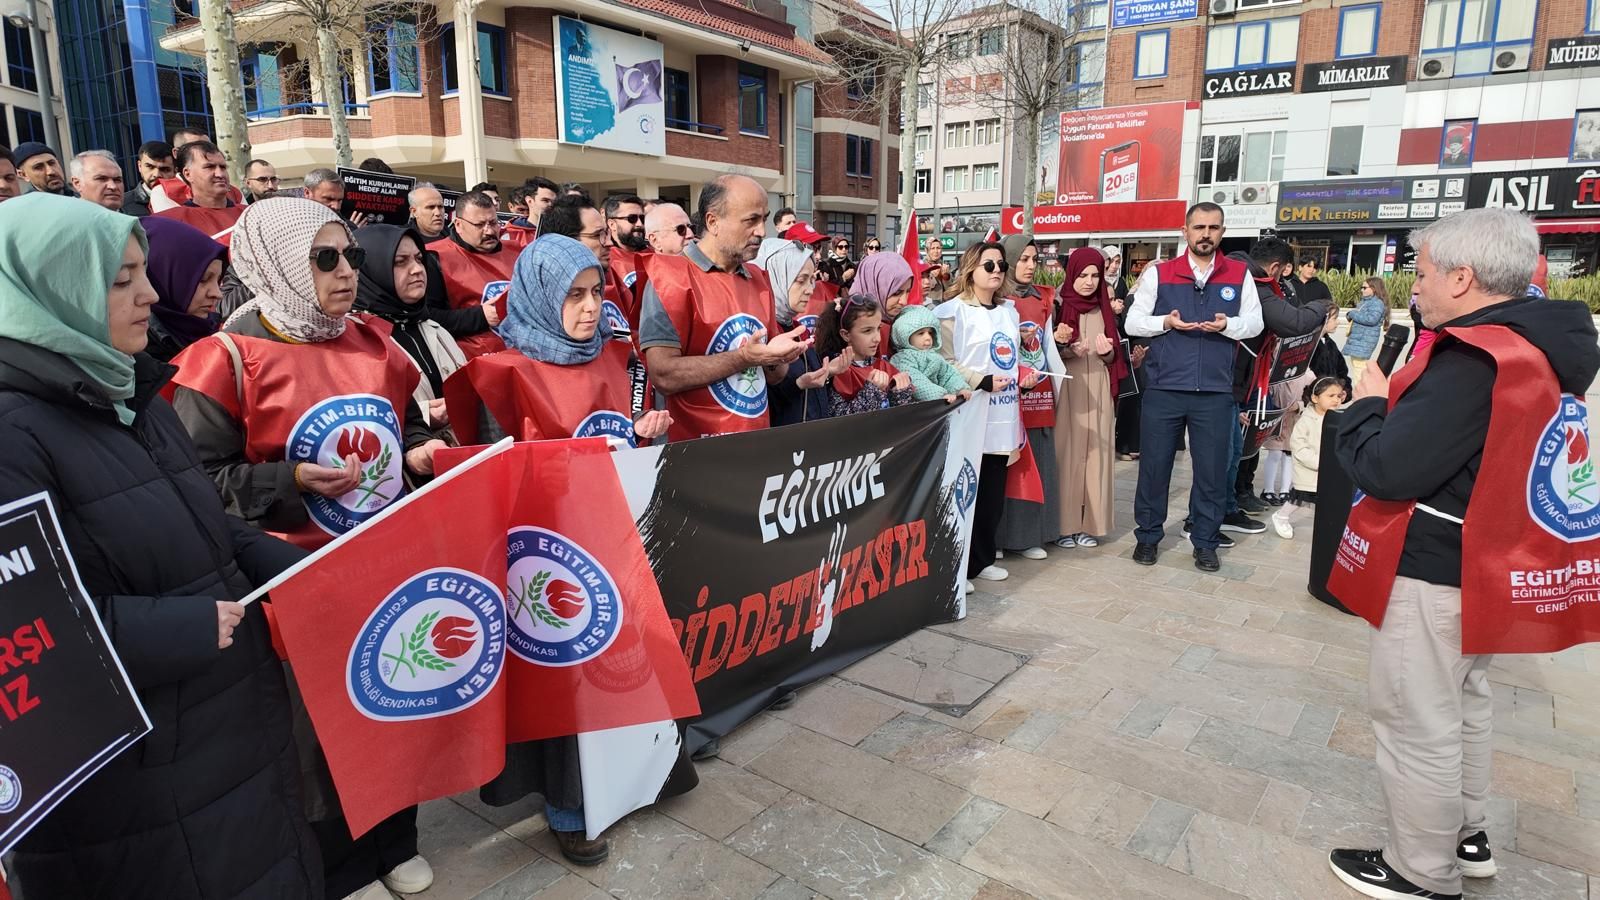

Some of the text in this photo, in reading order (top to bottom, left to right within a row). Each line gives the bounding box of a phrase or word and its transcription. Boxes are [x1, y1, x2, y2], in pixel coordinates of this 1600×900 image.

[1130, 2, 1168, 14] TÜRKAN
[1318, 65, 1390, 86] MİMARLIK
[1206, 72, 1292, 98] ÇAĞLAR
[1063, 119, 1146, 133] Uygun Faturalı Teklifler
[1062, 132, 1105, 142] Vodafone'da
[368, 180, 409, 190] KURUMLARINI
[1105, 172, 1135, 192] 20 GB
[358, 185, 397, 196] HEDEF ALAN
[1033, 213, 1081, 225] vodafone
[1279, 206, 1322, 222] CMR
[1325, 208, 1370, 222] İLETİŞİM
[831, 519, 929, 618] HAYIR
[1536, 601, 1568, 613] GENEL
[360, 595, 408, 668] EĞİTİMCİLER
[360, 668, 381, 702] BİRLİĞİ
[377, 695, 438, 709] SENDİKASI
